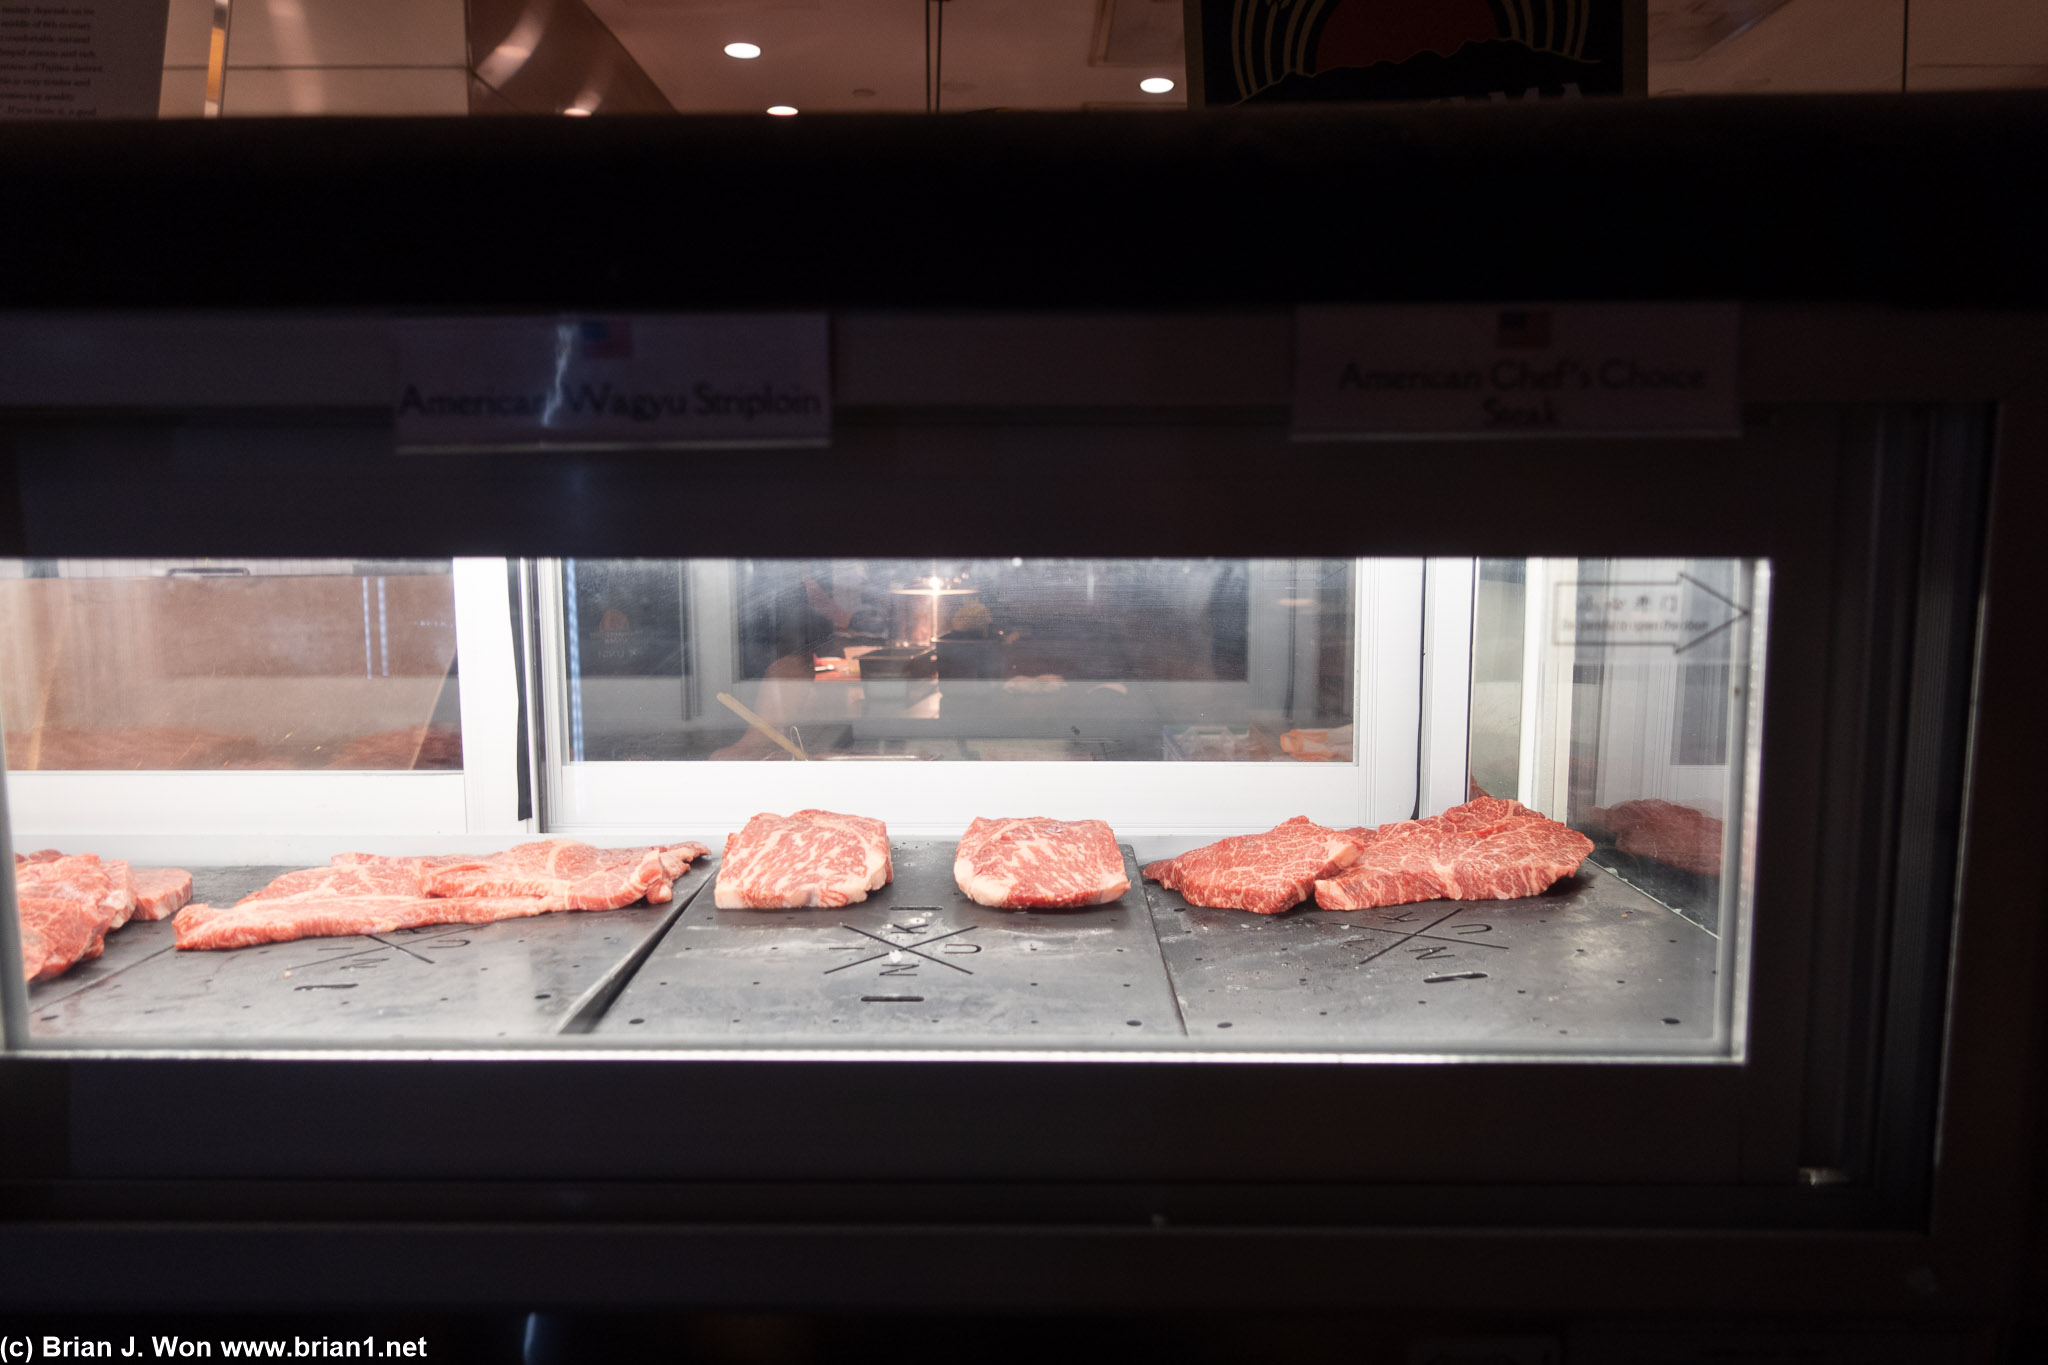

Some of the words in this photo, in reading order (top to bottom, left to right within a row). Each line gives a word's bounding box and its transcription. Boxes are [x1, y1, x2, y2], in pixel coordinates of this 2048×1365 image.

[1339, 361, 1482, 391] American
[1490, 359, 1591, 390] Chef's
[1599, 359, 1707, 390] Choice
[563, 382, 687, 421] Wagyu
[696, 382, 821, 421] Striploin
[1482, 398, 1559, 428] Steak
